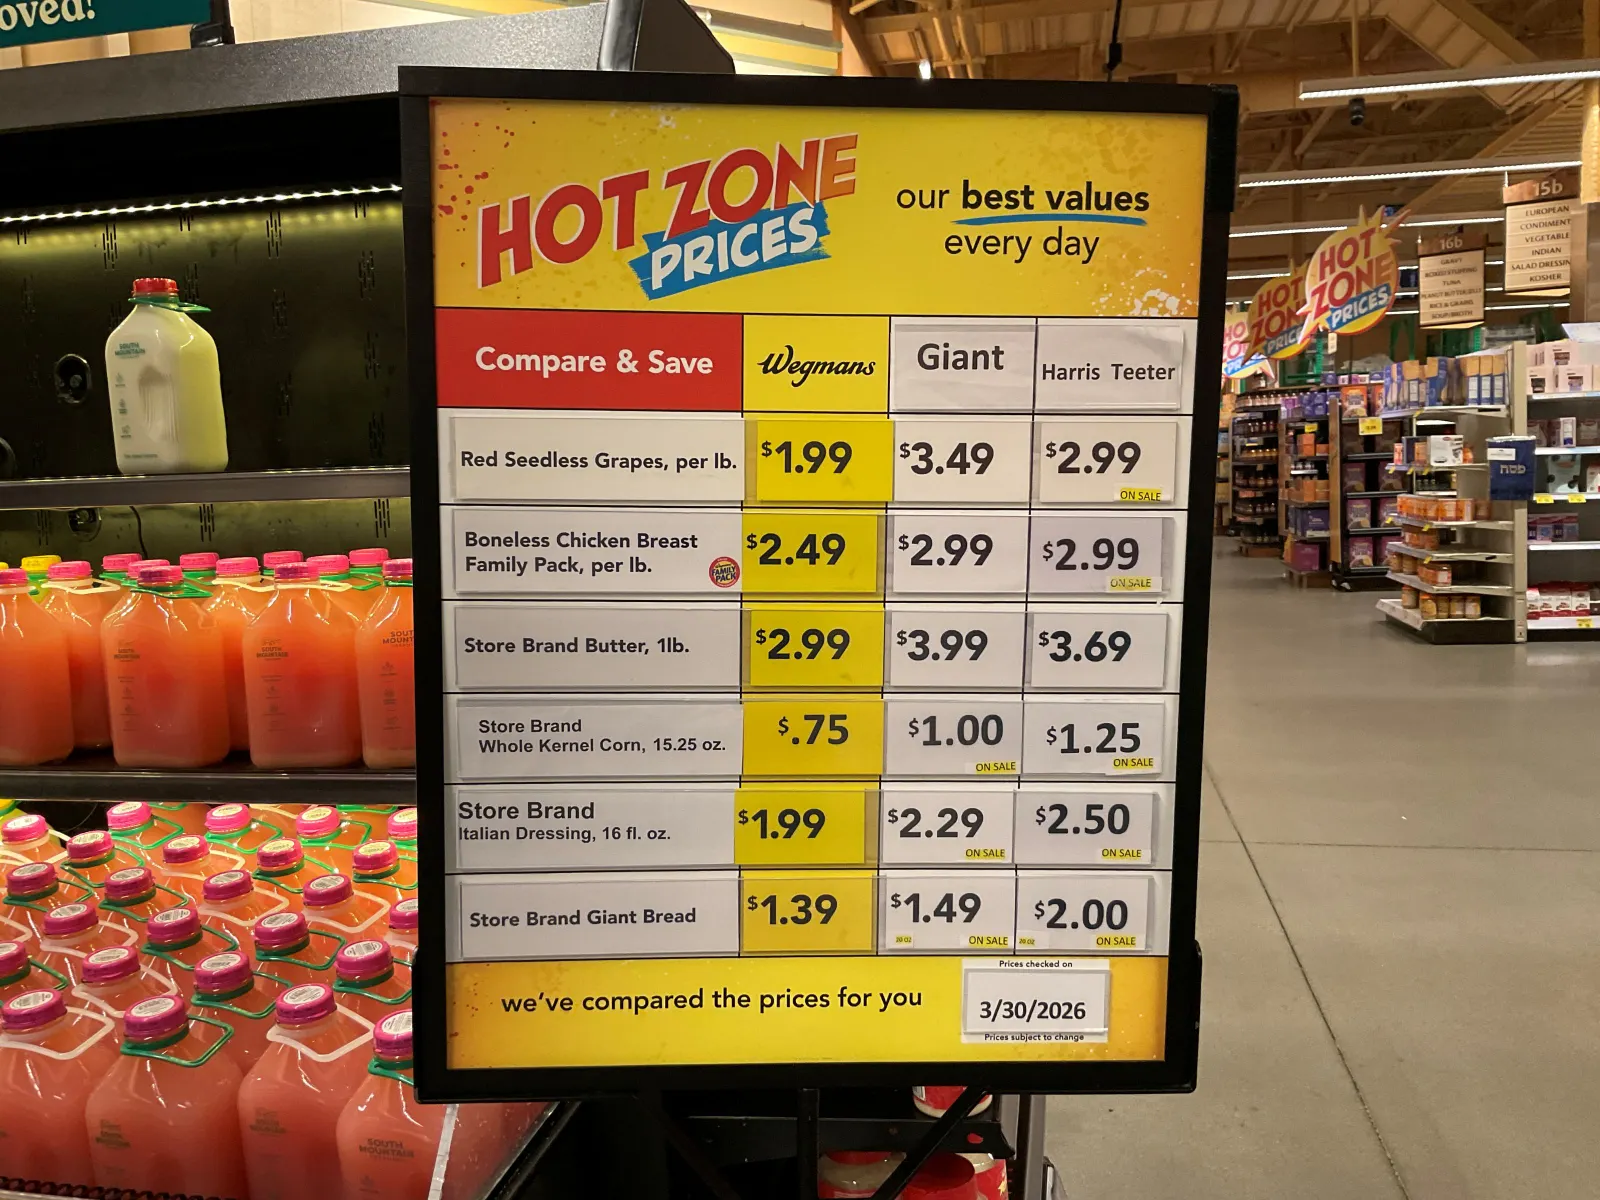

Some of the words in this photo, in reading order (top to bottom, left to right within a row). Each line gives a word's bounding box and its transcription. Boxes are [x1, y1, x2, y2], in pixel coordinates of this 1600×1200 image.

[896, 187, 950, 209] our
[962, 179, 1035, 210] best
[1045, 181, 1150, 211] values
[1532, 179, 1564, 197] 15b
[477, 169, 650, 289] HOT
[661, 132, 859, 242] ZONE
[1525, 205, 1570, 217] EUROPEAN
[650, 207, 819, 290] PRICES
[944, 233, 1033, 264] every
[1042, 226, 1100, 264] day
[1319, 228, 1376, 282] HOT
[1440, 235, 1463, 250] 16b
[1532, 246, 1562, 256] INDIAN
[1511, 262, 1538, 271] SALAD
[1538, 259, 1571, 269] DRESSIN
[1529, 273, 1562, 282] KOSHER
[1258, 276, 1304, 317] HOT
[1311, 251, 1393, 320] ZONE
[1331, 286, 1391, 328] PRICES
[1251, 299, 1306, 349] ZON
[475, 346, 607, 378] Compare
[616, 349, 640, 373] &
[648, 349, 714, 374] Save
[757, 344, 876, 387] Wegmans
[917, 343, 1005, 370] Giant
[1042, 363, 1100, 381] Harris
[1111, 364, 1176, 380] Teeter
[461, 451, 498, 467] Red
[504, 451, 589, 468] Seedless
[595, 453, 669, 473] Grapes,
[676, 456, 709, 473] per
[714, 453, 737, 470] lb.
[761, 440, 853, 474] $1.99
[899, 442, 995, 475] $3.49
[1045, 441, 1141, 474] $2.99
[1120, 490, 1136, 500] ON
[1138, 491, 1161, 501] SALE
[465, 531, 550, 548] Boneless
[556, 532, 631, 549] Chicken
[637, 533, 698, 549] Breast
[746, 532, 846, 566] $2.49
[898, 533, 994, 566] $2.99
[465, 556, 528, 577] Family
[534, 557, 584, 575] Pack,
[591, 560, 623, 577] per
[629, 557, 653, 573] lb.
[1042, 538, 1139, 571] $2.99
[712, 565, 736, 576] FAMILY
[716, 572, 737, 582] PACK
[1110, 578, 1126, 588] ON
[1128, 578, 1152, 588] SALE
[383, 636, 414, 645] MOUNT
[390, 629, 414, 638] SOUT
[464, 637, 516, 653] Store
[523, 637, 579, 653] Brand
[585, 638, 650, 655] Butter,
[657, 637, 690, 654] 1lb.
[755, 628, 850, 660] $2.99
[896, 629, 988, 661] $3.99
[1038, 630, 1132, 662] $3.69
[479, 719, 525, 733] Store
[530, 719, 582, 733] Brand
[778, 713, 849, 745] $.75
[908, 714, 1004, 746] $1.00
[1046, 722, 1141, 754] $1.25
[479, 739, 534, 753] Whole
[539, 738, 594, 752] Kernel
[599, 738, 646, 754] Corn,
[653, 737, 697, 751] 15.25
[702, 740, 726, 751] oz.
[975, 763, 991, 772] ON
[993, 762, 1016, 771] SALE
[1113, 758, 1128, 767] ON
[1131, 758, 1153, 767] SALE
[458, 801, 519, 819] Store
[527, 801, 595, 819] Brand
[887, 807, 984, 838] $2.29
[1035, 804, 1130, 834] $2.50
[458, 827, 510, 840] Italian
[516, 826, 597, 843] Dressing,
[602, 827, 621, 840] 16
[626, 826, 642, 840] fl.
[647, 830, 671, 840] oz.
[738, 808, 826, 839] $1.99
[965, 849, 981, 857] ON
[983, 849, 1005, 858] SALE
[1101, 848, 1117, 857] ON
[1119, 849, 1142, 857] SALE
[470, 912, 520, 927] Store
[526, 910, 581, 926] Brand
[587, 909, 637, 925] Giant
[643, 908, 696, 924] Bread
[747, 893, 838, 925] $1.39
[891, 892, 982, 923] $1.49
[1034, 898, 1128, 930] $2.00
[968, 936, 984, 945] ON
[986, 936, 1009, 945] SALE
[1096, 936, 1113, 946] ON
[1114, 936, 1136, 946] SALE
[999, 960, 1024, 968] Prices
[1026, 960, 1060, 968] checked
[501, 992, 574, 1012] we’ve
[582, 987, 704, 1015] compared
[711, 987, 751, 1008] the
[759, 988, 830, 1014] prices
[837, 986, 873, 1007] for
[878, 991, 922, 1013] you
[979, 998, 1087, 1023] 3/30/2026
[1011, 1034, 1042, 1042] subject
[1054, 1034, 1085, 1042] change
[367, 1138, 404, 1149] SOUTH
